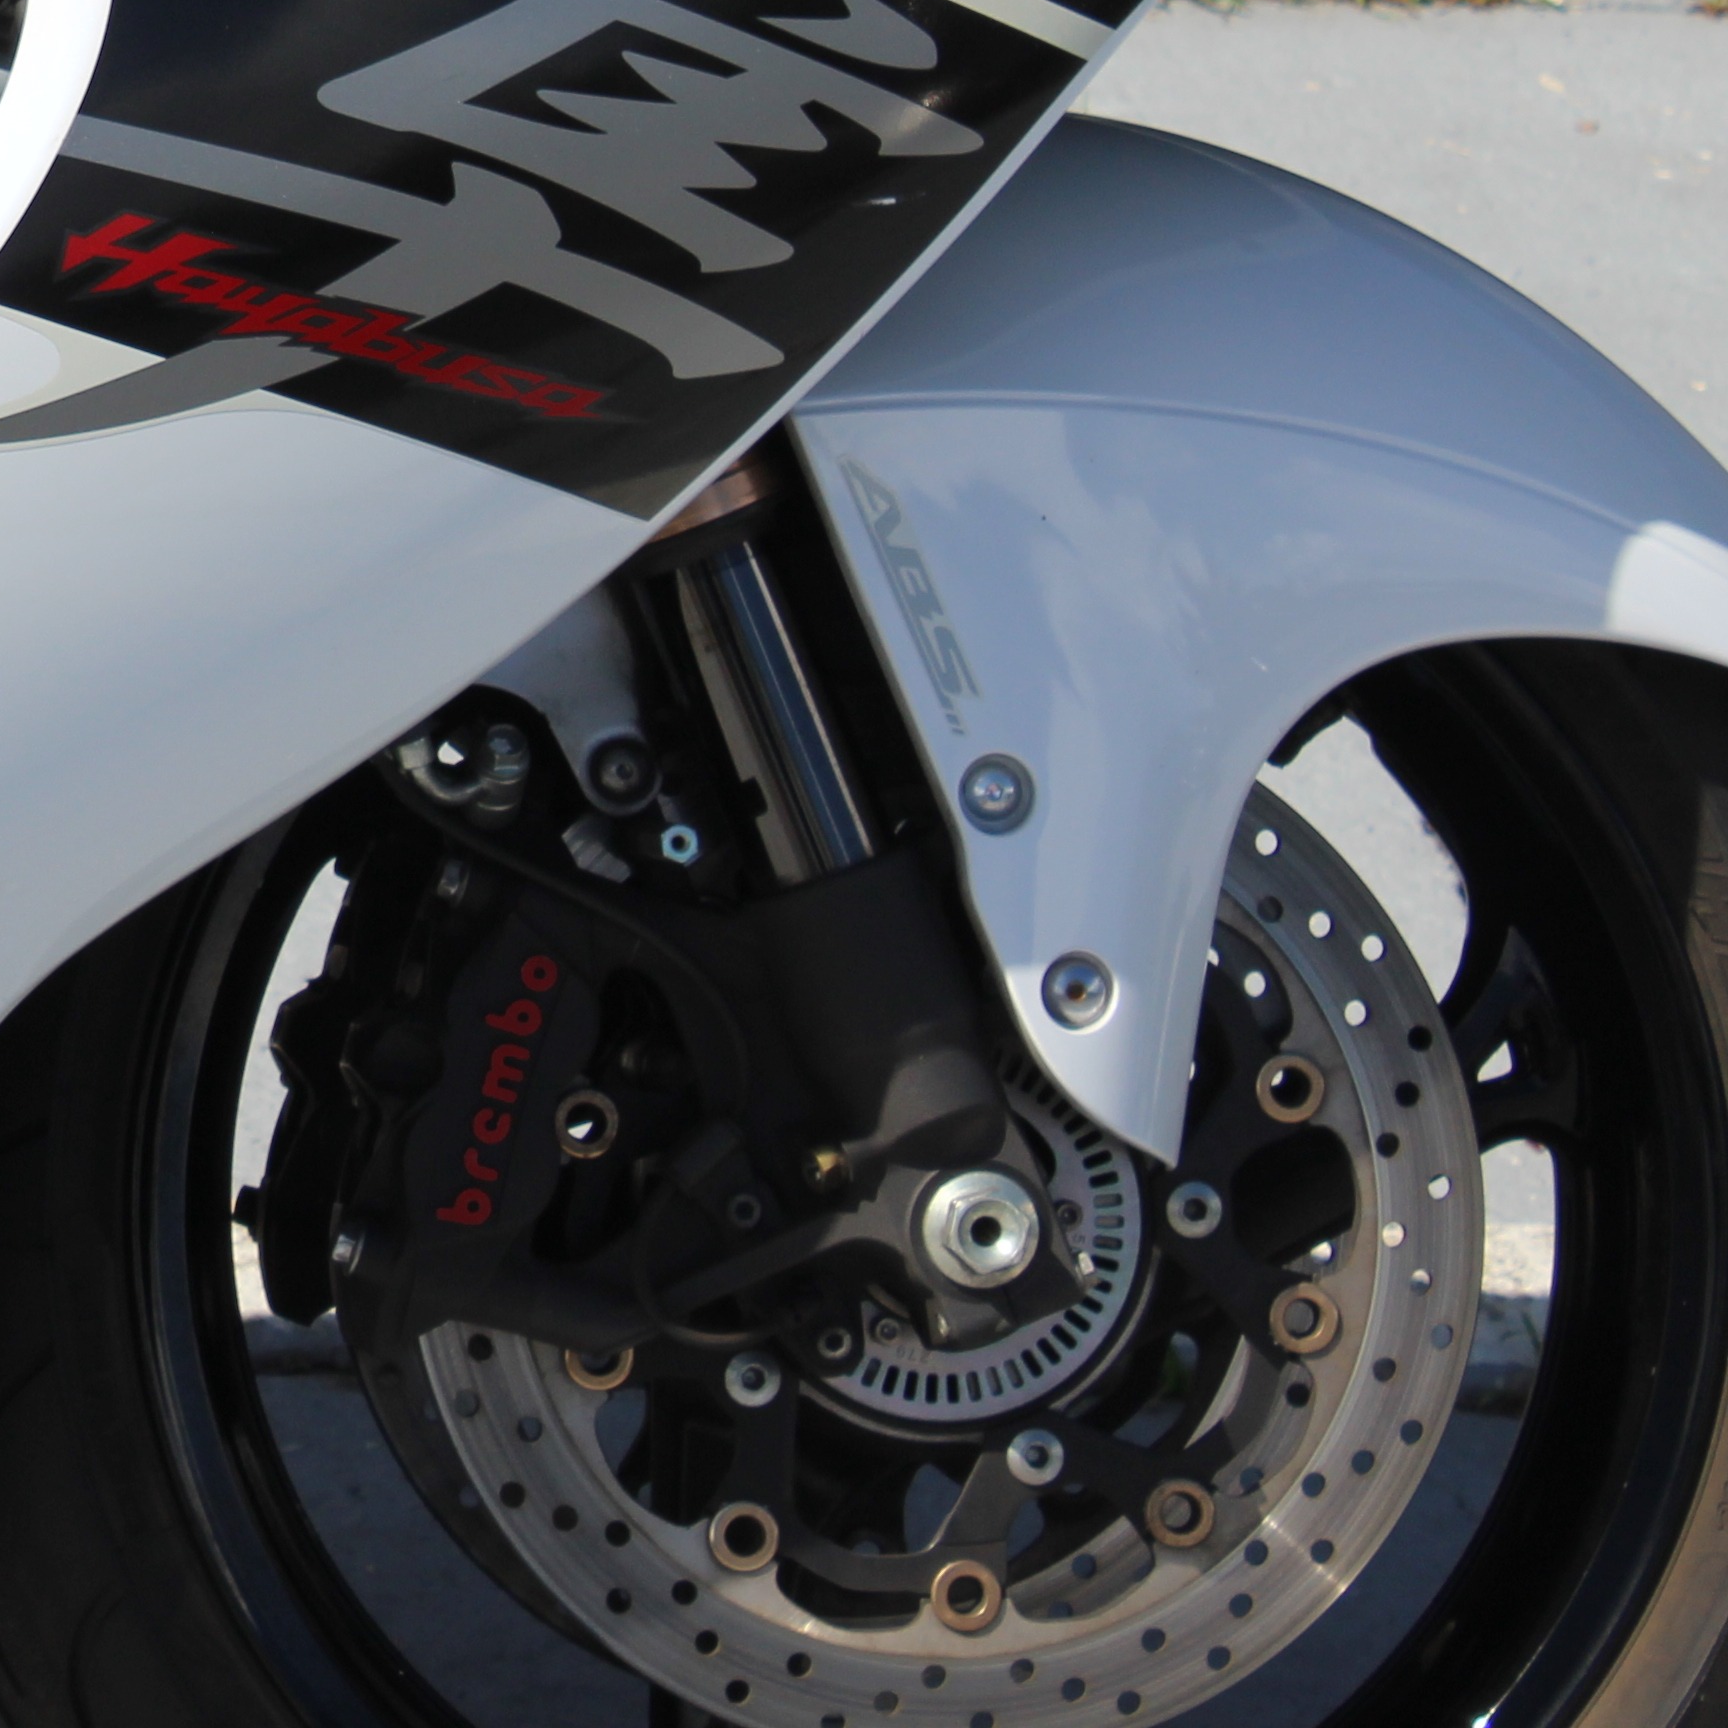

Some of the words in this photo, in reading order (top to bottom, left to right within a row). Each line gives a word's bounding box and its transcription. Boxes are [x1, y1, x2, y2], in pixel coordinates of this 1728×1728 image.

[61, 213, 613, 419] Hayabusa
[841, 456, 981, 702] ABS
[435, 954, 558, 1225] brembo
